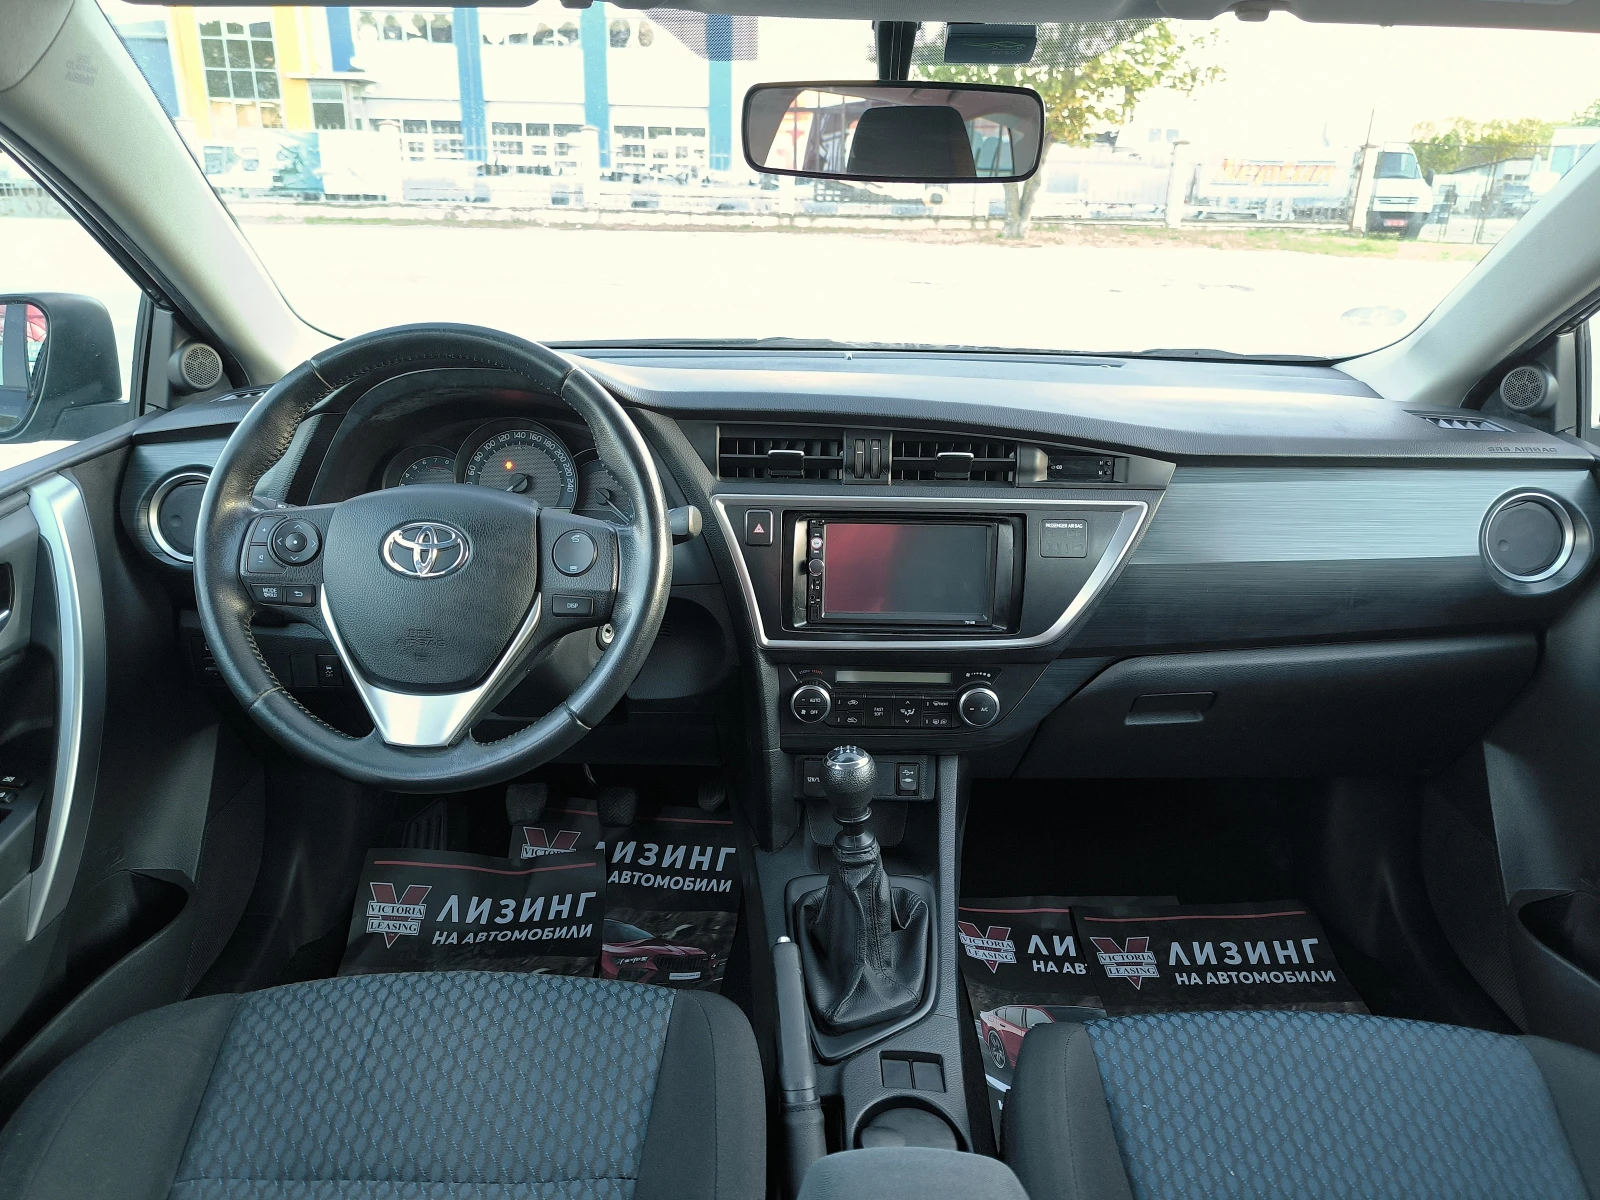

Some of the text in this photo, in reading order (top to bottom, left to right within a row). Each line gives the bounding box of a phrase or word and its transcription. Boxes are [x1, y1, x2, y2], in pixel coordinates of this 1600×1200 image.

[497, 433, 510, 443] 120
[513, 431, 526, 439] 140
[528, 432, 542, 442] 160
[483, 440, 496, 451] 100
[543, 438, 556, 450] 180
[473, 451, 484, 462] 80
[554, 449, 567, 463] 200
[468, 465, 476, 476] 60
[562, 463, 573, 477] 220
[608, 870, 732, 893] АВТОМОБИЛИ
[370, 904, 424, 916] VICTORIA
[436, 891, 597, 925] ЛИЗИНГ
[370, 922, 418, 932] LEASING
[432, 923, 593, 945] НА АВТОМОБИЛИ
[961, 934, 1013, 949] VICTORIA
[967, 946, 1014, 960] LEASING
[1100, 953, 1154, 962] VICTORIA
[1168, 938, 1318, 966] ЛИЗИНГ
[1032, 960, 1088, 975] НА АВ
[1109, 967, 1155, 975] LEASING
[1174, 970, 1337, 986] НА АВТОМОБИЛИ
